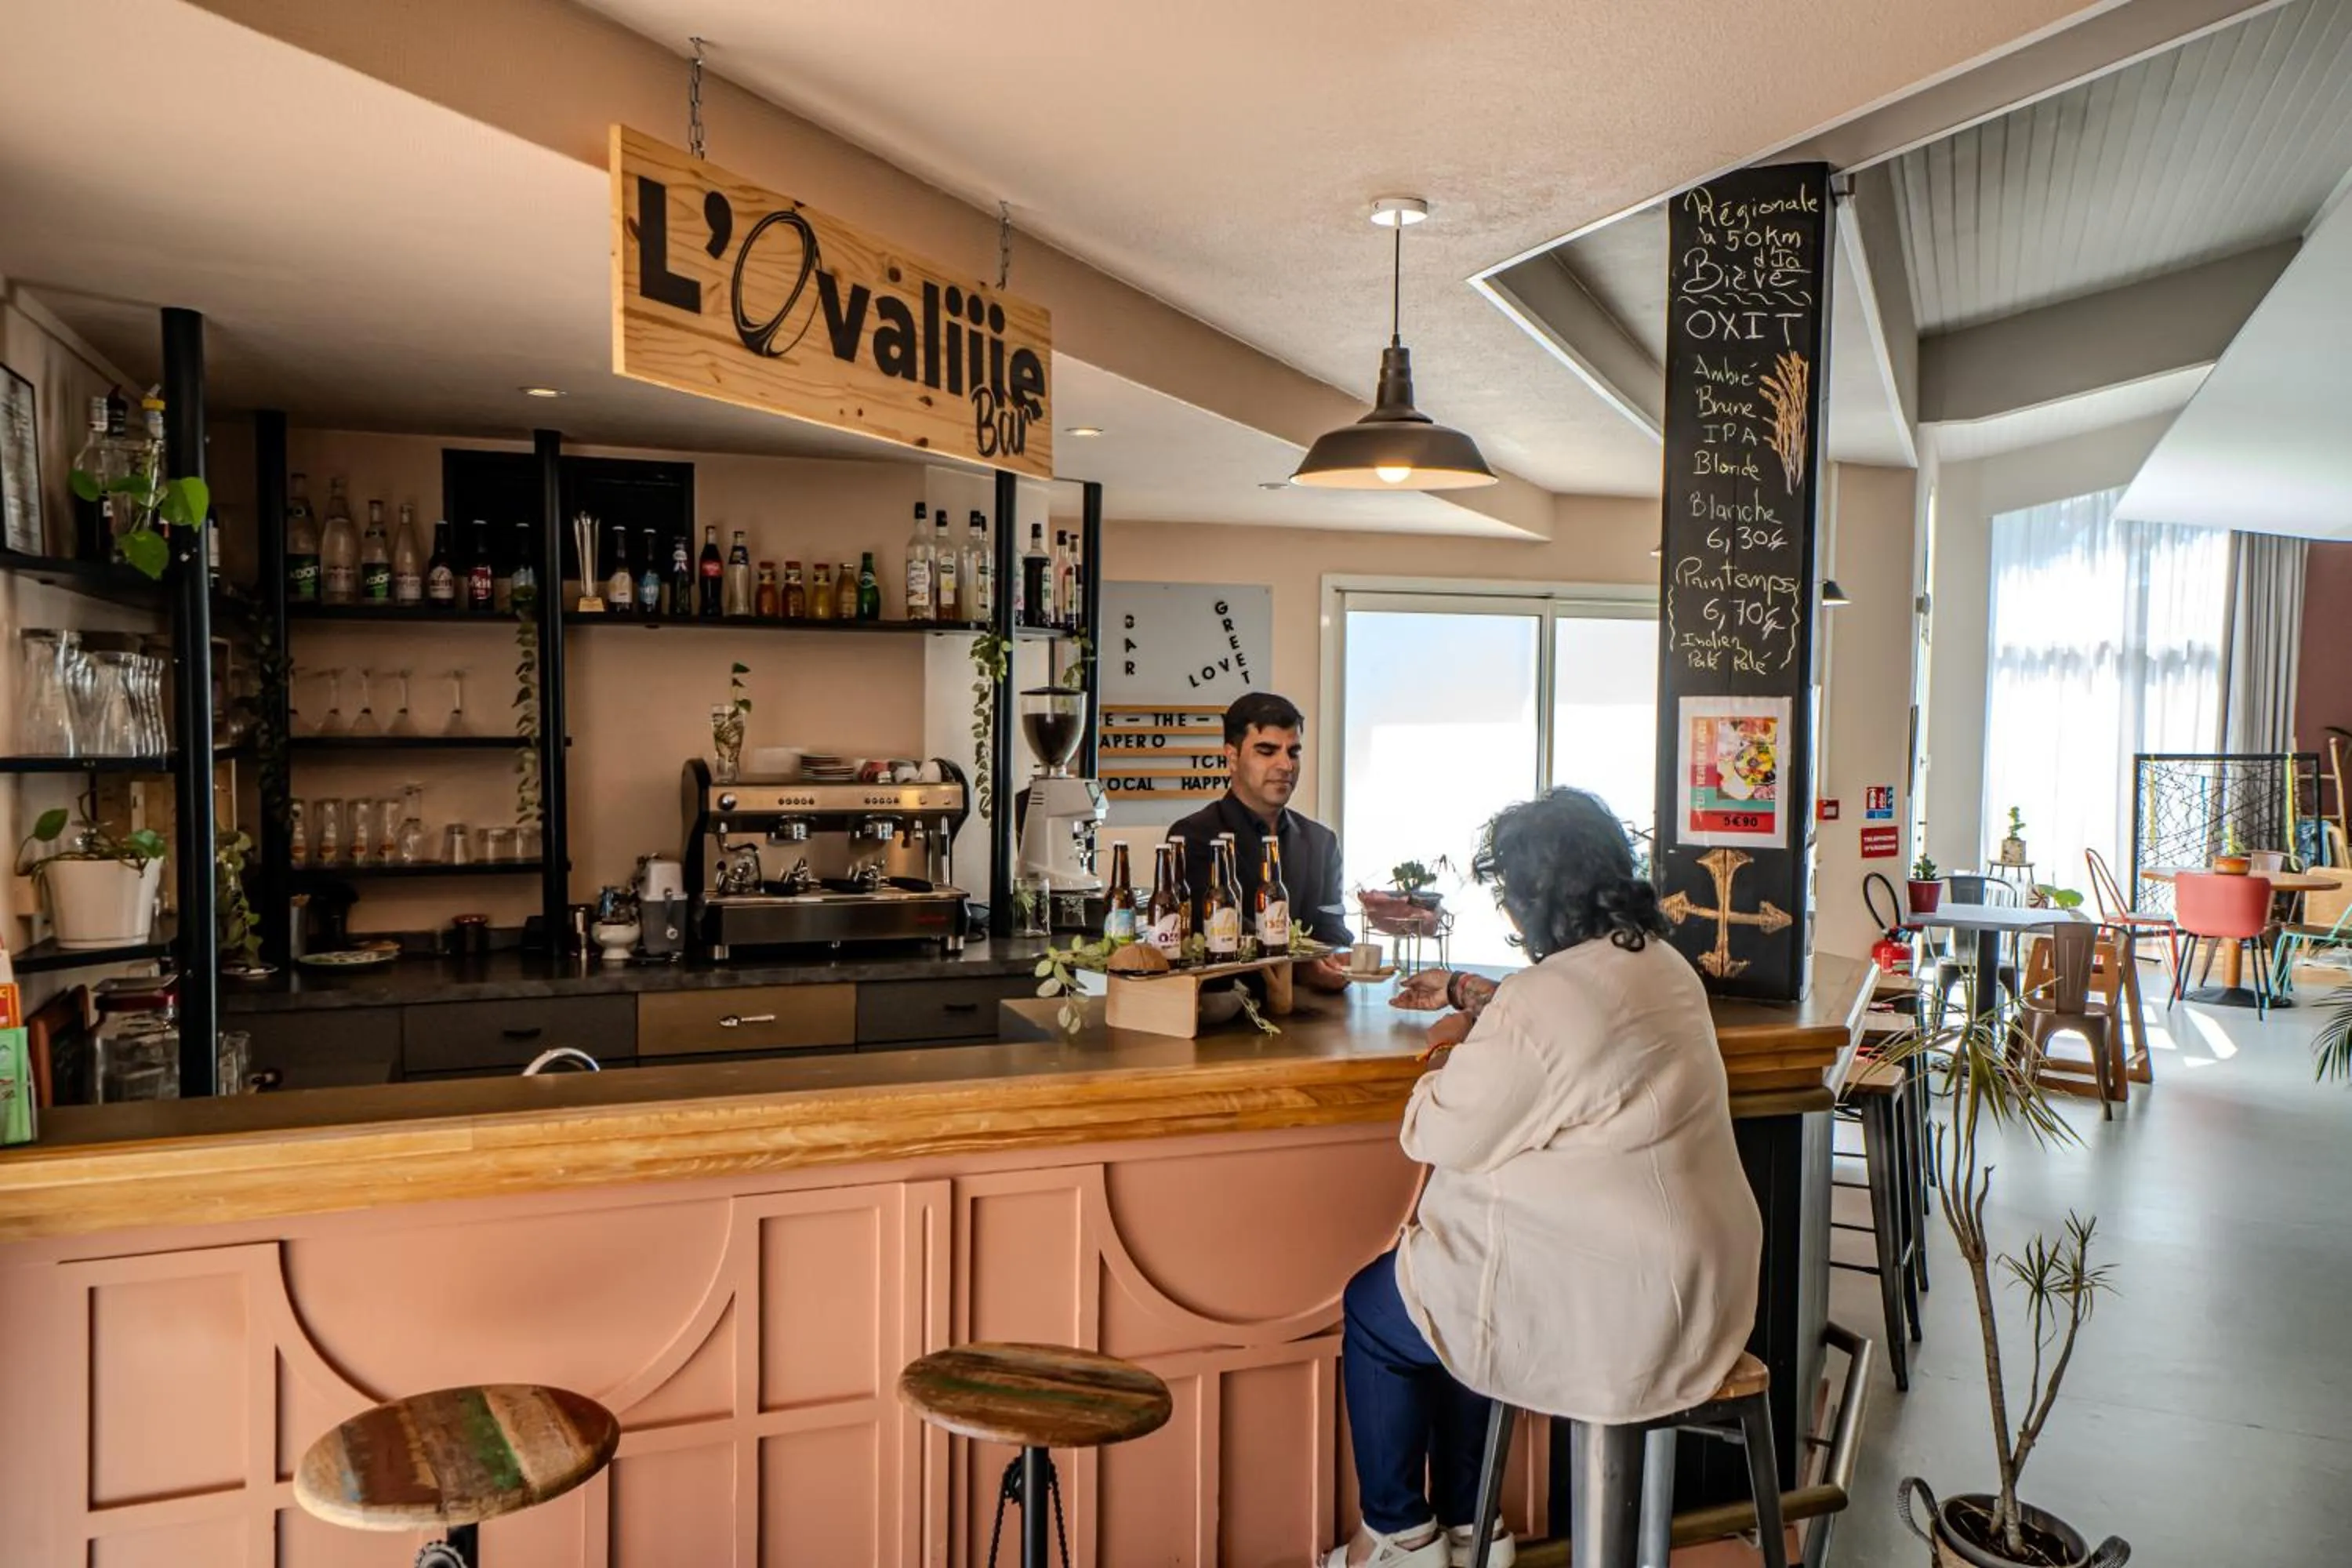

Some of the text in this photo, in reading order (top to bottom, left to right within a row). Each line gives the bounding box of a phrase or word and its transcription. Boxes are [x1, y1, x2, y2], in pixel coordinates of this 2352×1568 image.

[1684, 183, 1819, 230] Régionale
[1686, 310, 1804, 346] OXIT
[1696, 385, 1757, 419] Brune
[970, 385, 1033, 458] Bar
[1702, 423, 1759, 446] IPA
[1693, 450, 1762, 481] Blonde
[1690, 487, 1783, 524] Blanche
[1214, 600, 1251, 685] GREET
[1153, 713, 1187, 727] THE
[1099, 733, 1166, 748] APERO
[1098, 776, 1231, 791] OCAL HAPPY
